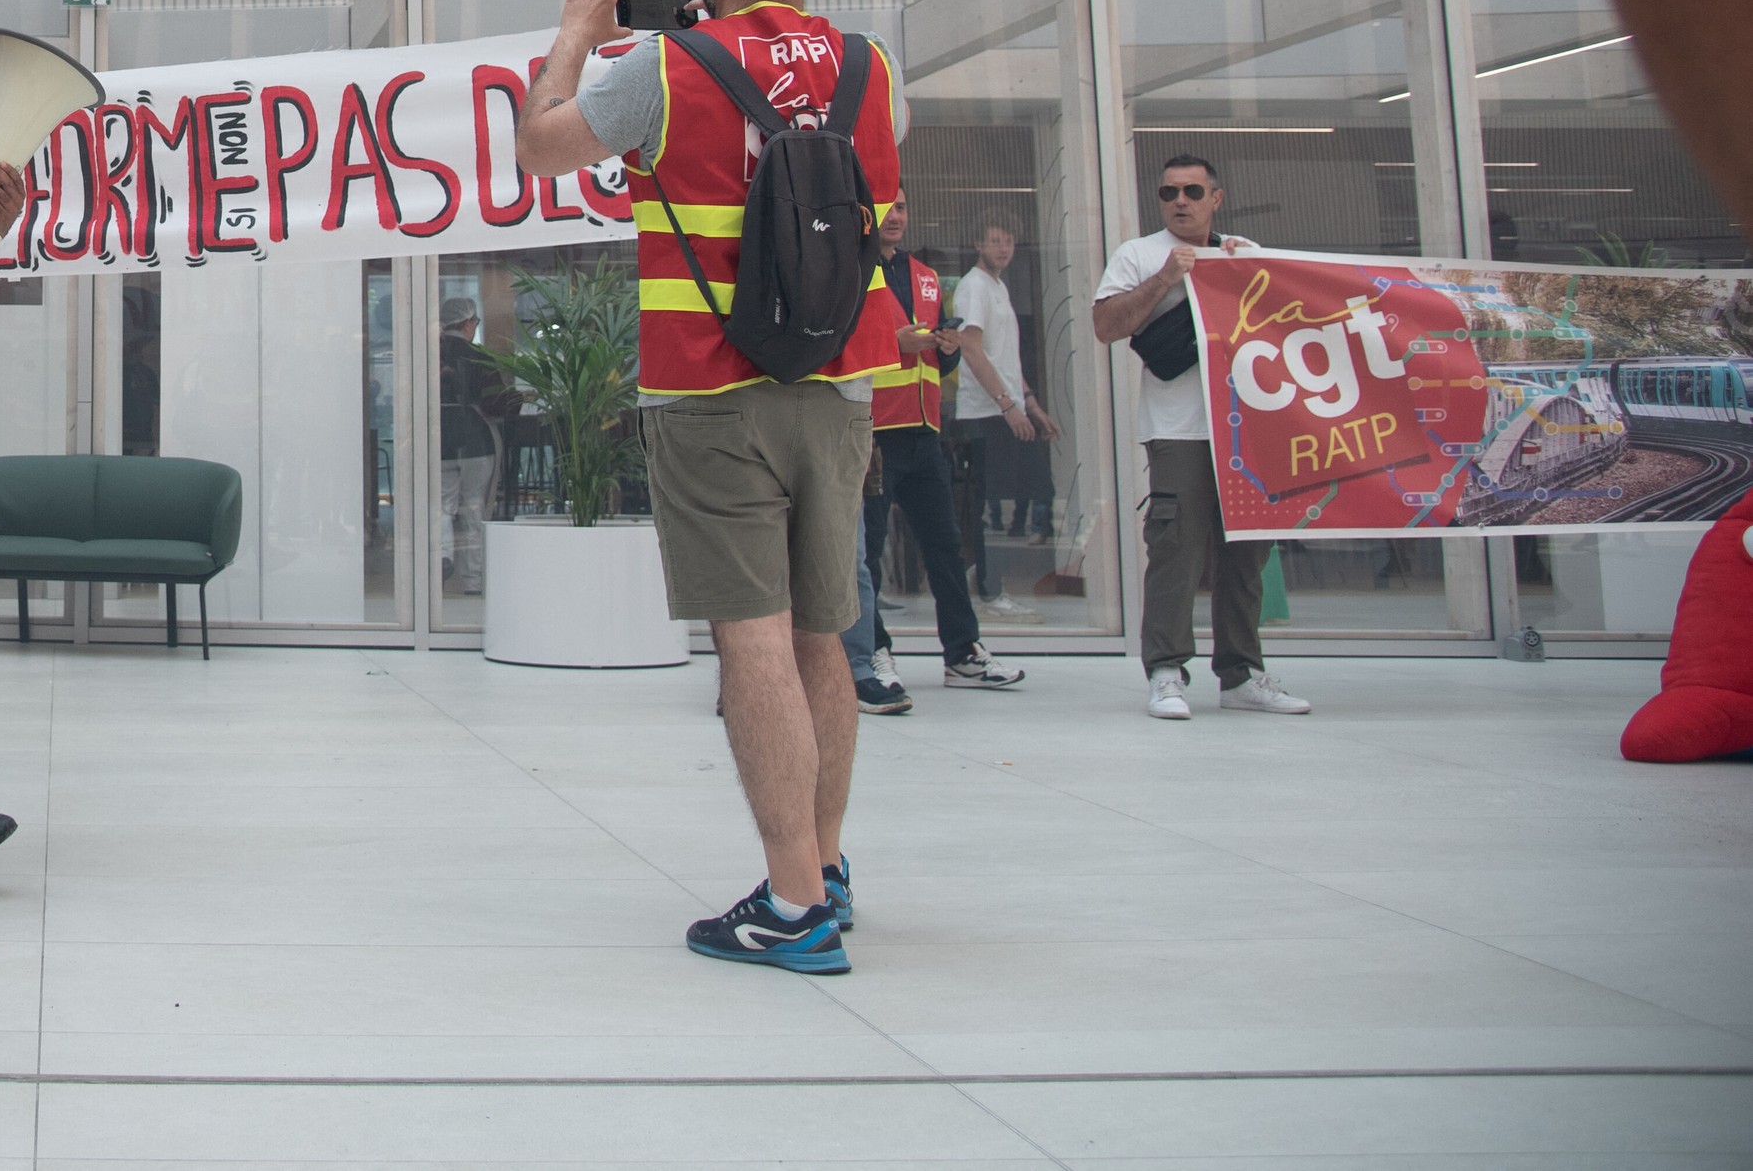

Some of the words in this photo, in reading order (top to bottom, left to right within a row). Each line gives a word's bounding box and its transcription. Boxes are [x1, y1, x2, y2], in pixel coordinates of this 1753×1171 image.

[770, 38, 827, 66] RAP
[261, 70, 462, 243] PAS
[1229, 268, 1380, 345] la
[1231, 294, 1406, 419] cgt
[1290, 412, 1398, 477] RATP
